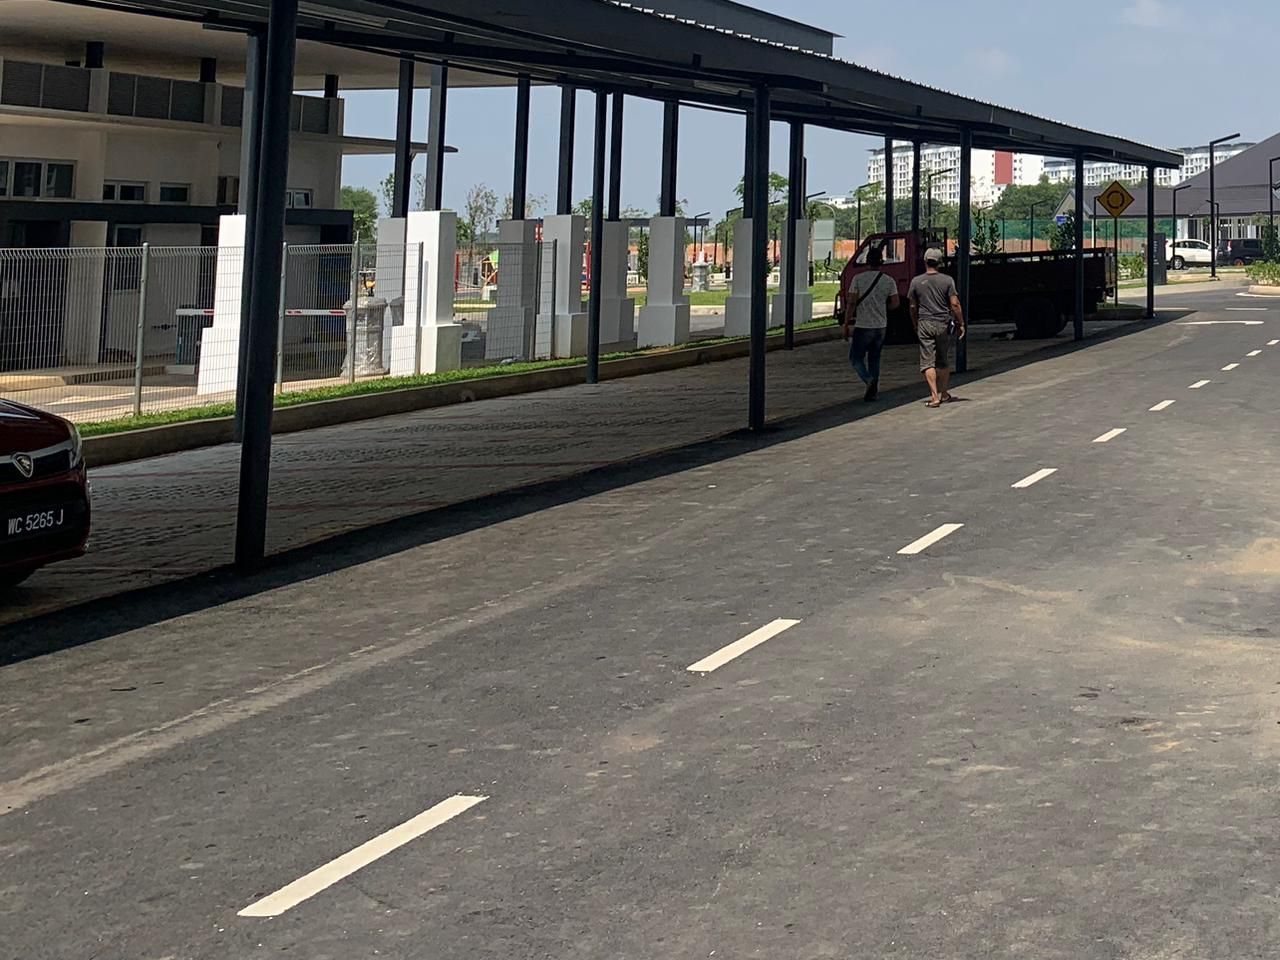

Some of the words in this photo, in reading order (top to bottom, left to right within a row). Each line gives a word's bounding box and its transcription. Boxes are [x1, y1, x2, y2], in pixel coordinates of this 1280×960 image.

[8, 517, 23, 535] WC
[25, 510, 54, 531] 5265
[56, 508, 64, 525] J
